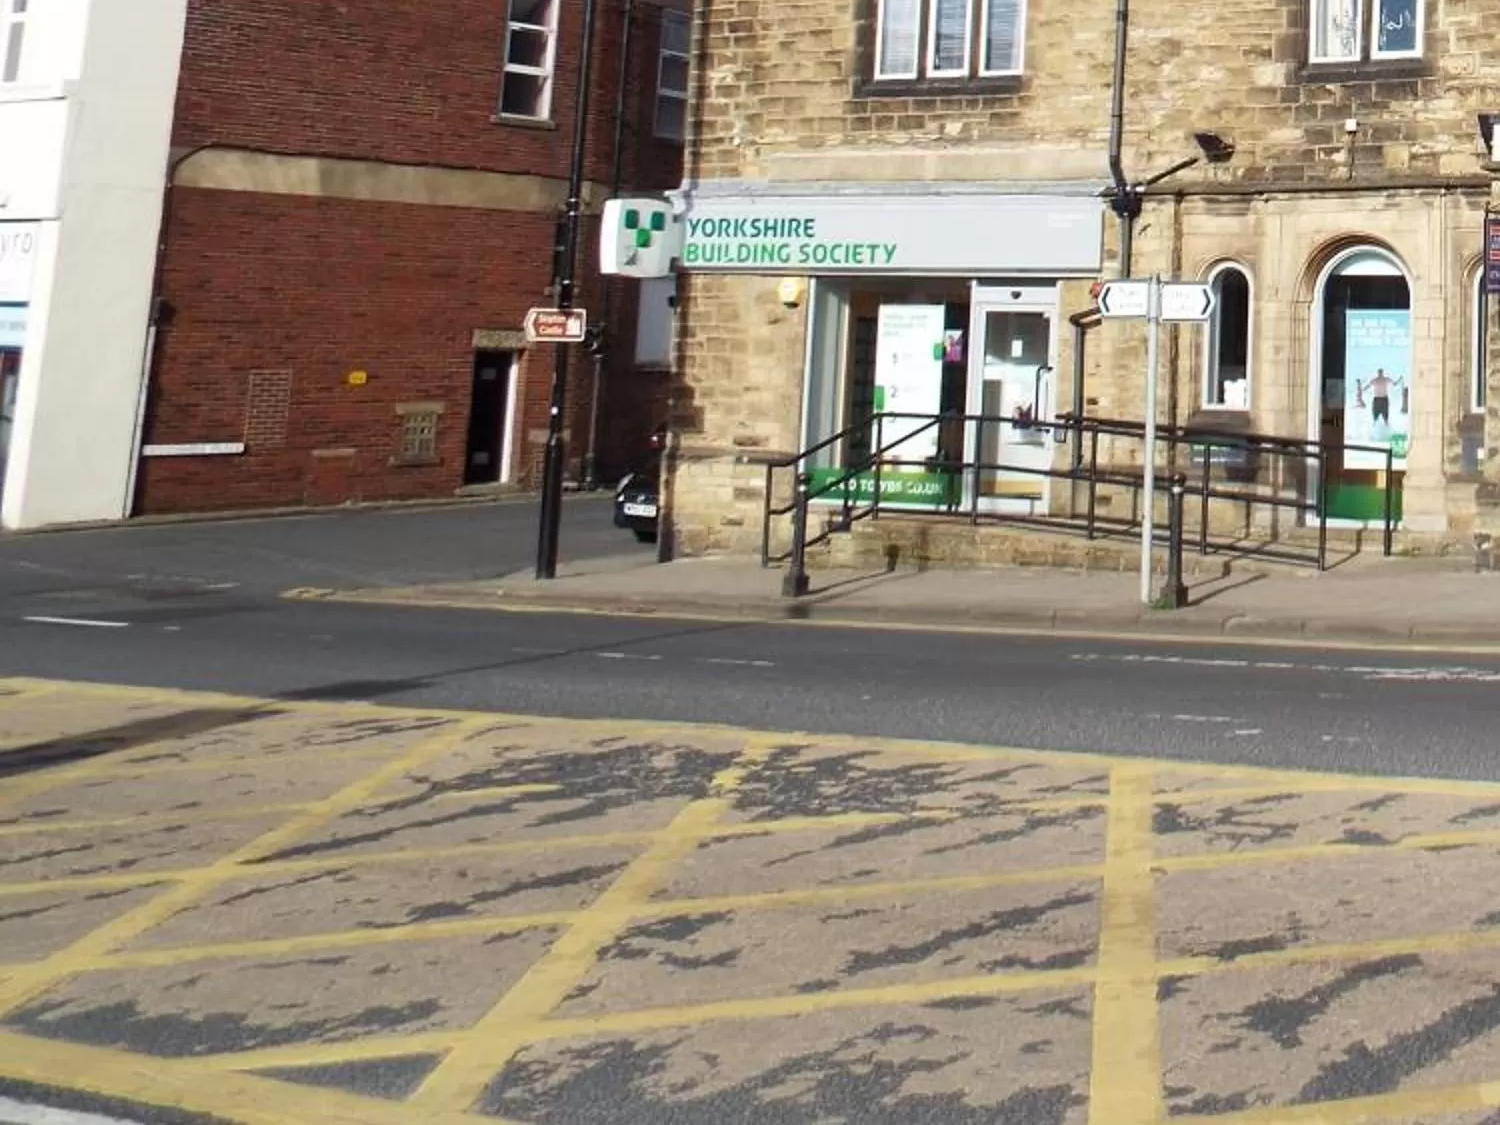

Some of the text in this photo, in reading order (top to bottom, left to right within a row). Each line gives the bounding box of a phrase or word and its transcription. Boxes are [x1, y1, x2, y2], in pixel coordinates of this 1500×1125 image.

[687, 218, 816, 238] YORKSHIRE
[685, 242, 897, 264] BUILDING SOCIETY
